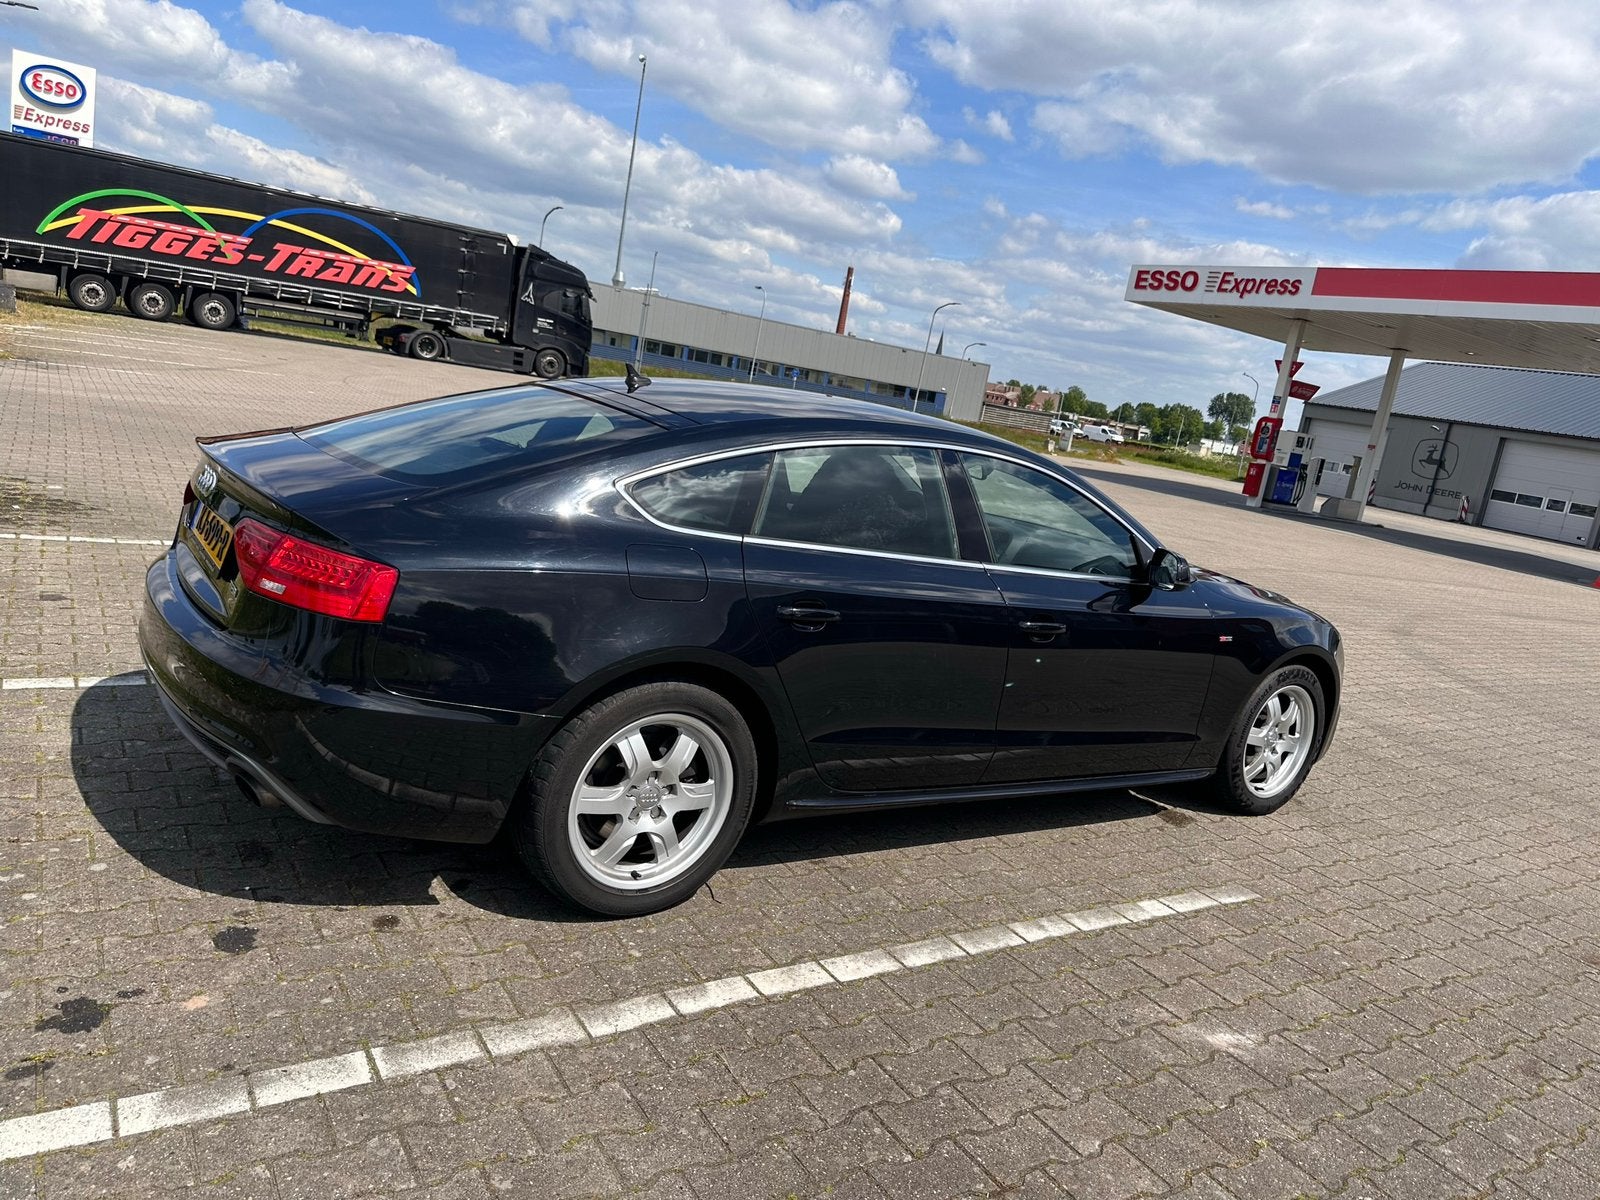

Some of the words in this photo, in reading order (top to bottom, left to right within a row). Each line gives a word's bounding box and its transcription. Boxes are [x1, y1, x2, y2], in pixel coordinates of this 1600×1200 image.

[23, 107, 91, 134] Express
[1134, 270, 1200, 292] ESSO
[1216, 272, 1303, 298] Express
[1394, 480, 1424, 492] JOHN
